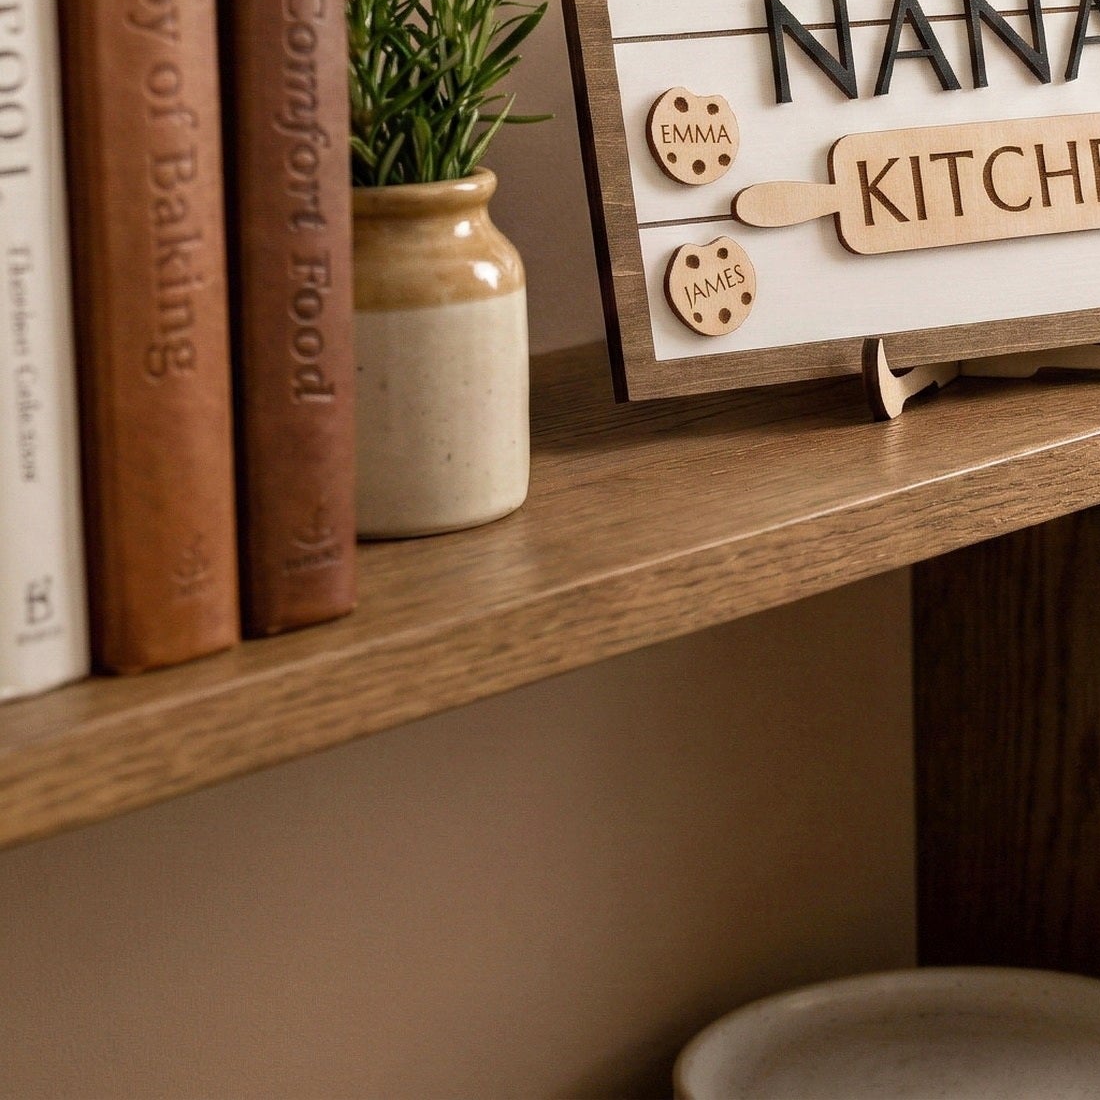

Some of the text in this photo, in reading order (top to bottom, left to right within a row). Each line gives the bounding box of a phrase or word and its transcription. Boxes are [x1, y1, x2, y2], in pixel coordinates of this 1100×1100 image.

[145, 61, 198, 128] of
[660, 124, 732, 145] EMMA
[144, 147, 199, 383] Baking
[684, 264, 746, 309] JAMES
[288, 250, 335, 404] Food
